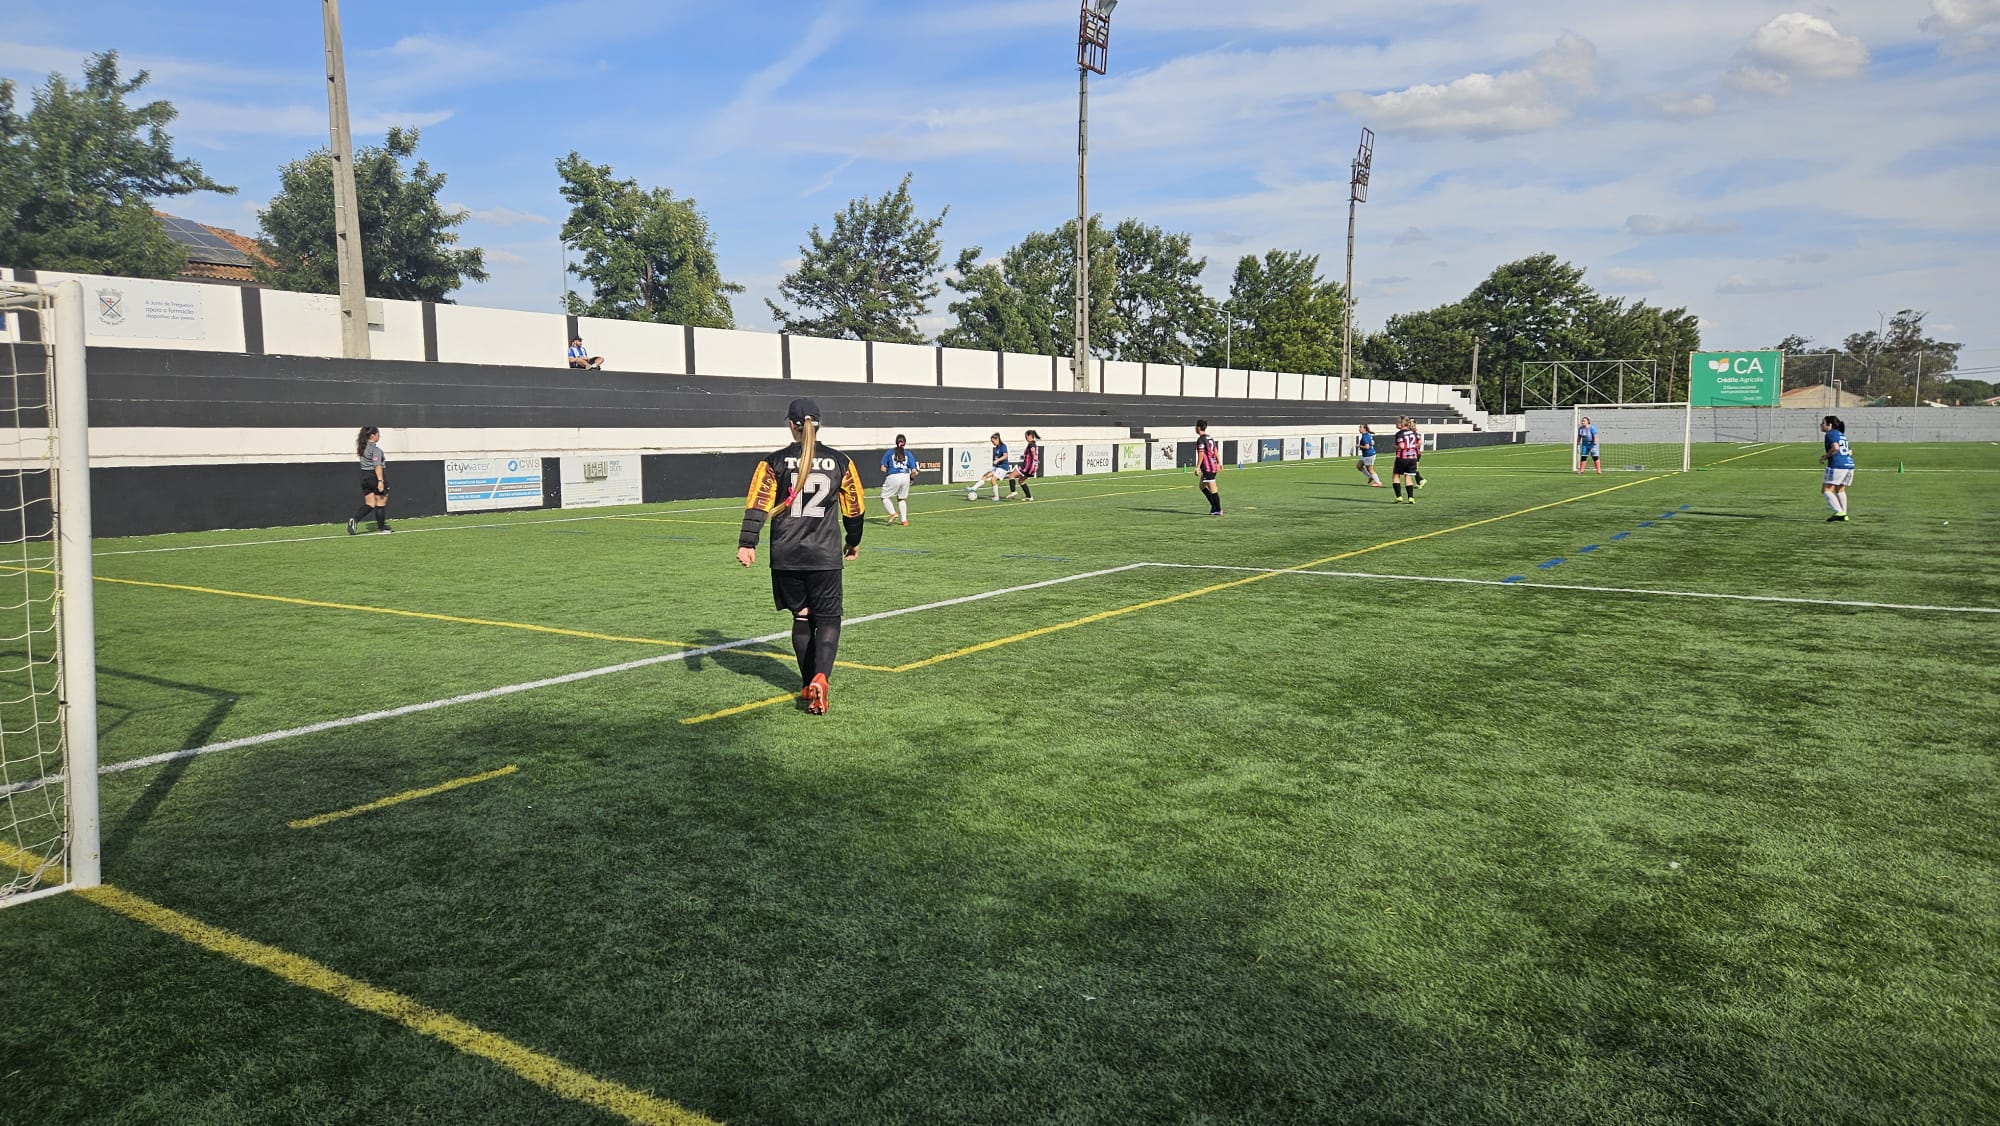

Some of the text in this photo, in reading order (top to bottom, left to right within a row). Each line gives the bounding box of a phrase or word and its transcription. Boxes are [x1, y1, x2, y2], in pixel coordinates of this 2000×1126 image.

[1734, 358, 1763, 374] CA
[1404, 434, 1416, 448] 12
[518, 459, 540, 468] CWS
[1087, 458, 1109, 467] PACHECO
[790, 472, 831, 517] 12
